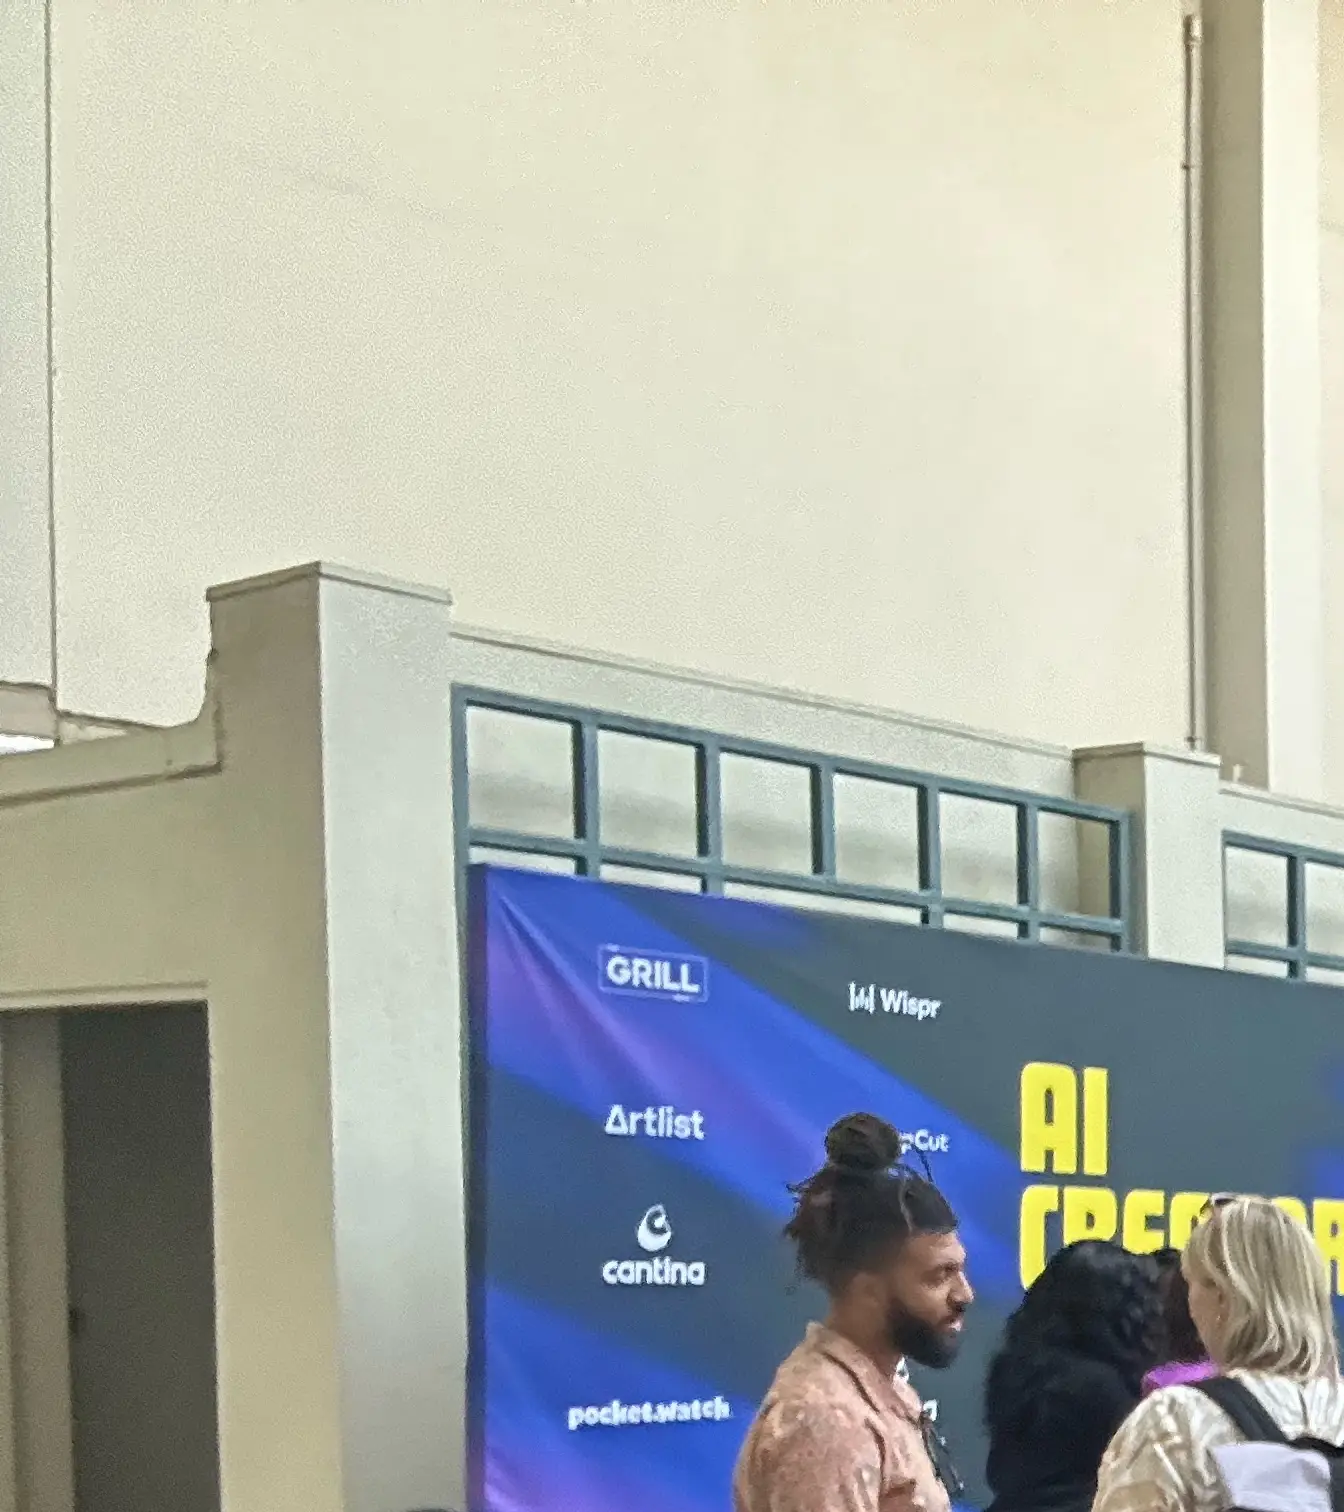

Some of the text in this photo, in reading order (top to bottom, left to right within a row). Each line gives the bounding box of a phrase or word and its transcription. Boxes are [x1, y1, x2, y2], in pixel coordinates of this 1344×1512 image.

[605, 955, 700, 993] GRILL
[879, 987, 941, 1021] Wispr
[604, 1104, 705, 1140] Artlist
[1020, 1063, 1108, 1176] AI
[900, 1129, 949, 1155] pCut
[602, 1255, 706, 1286] cantina
[567, 1395, 730, 1431] pocket.watch
